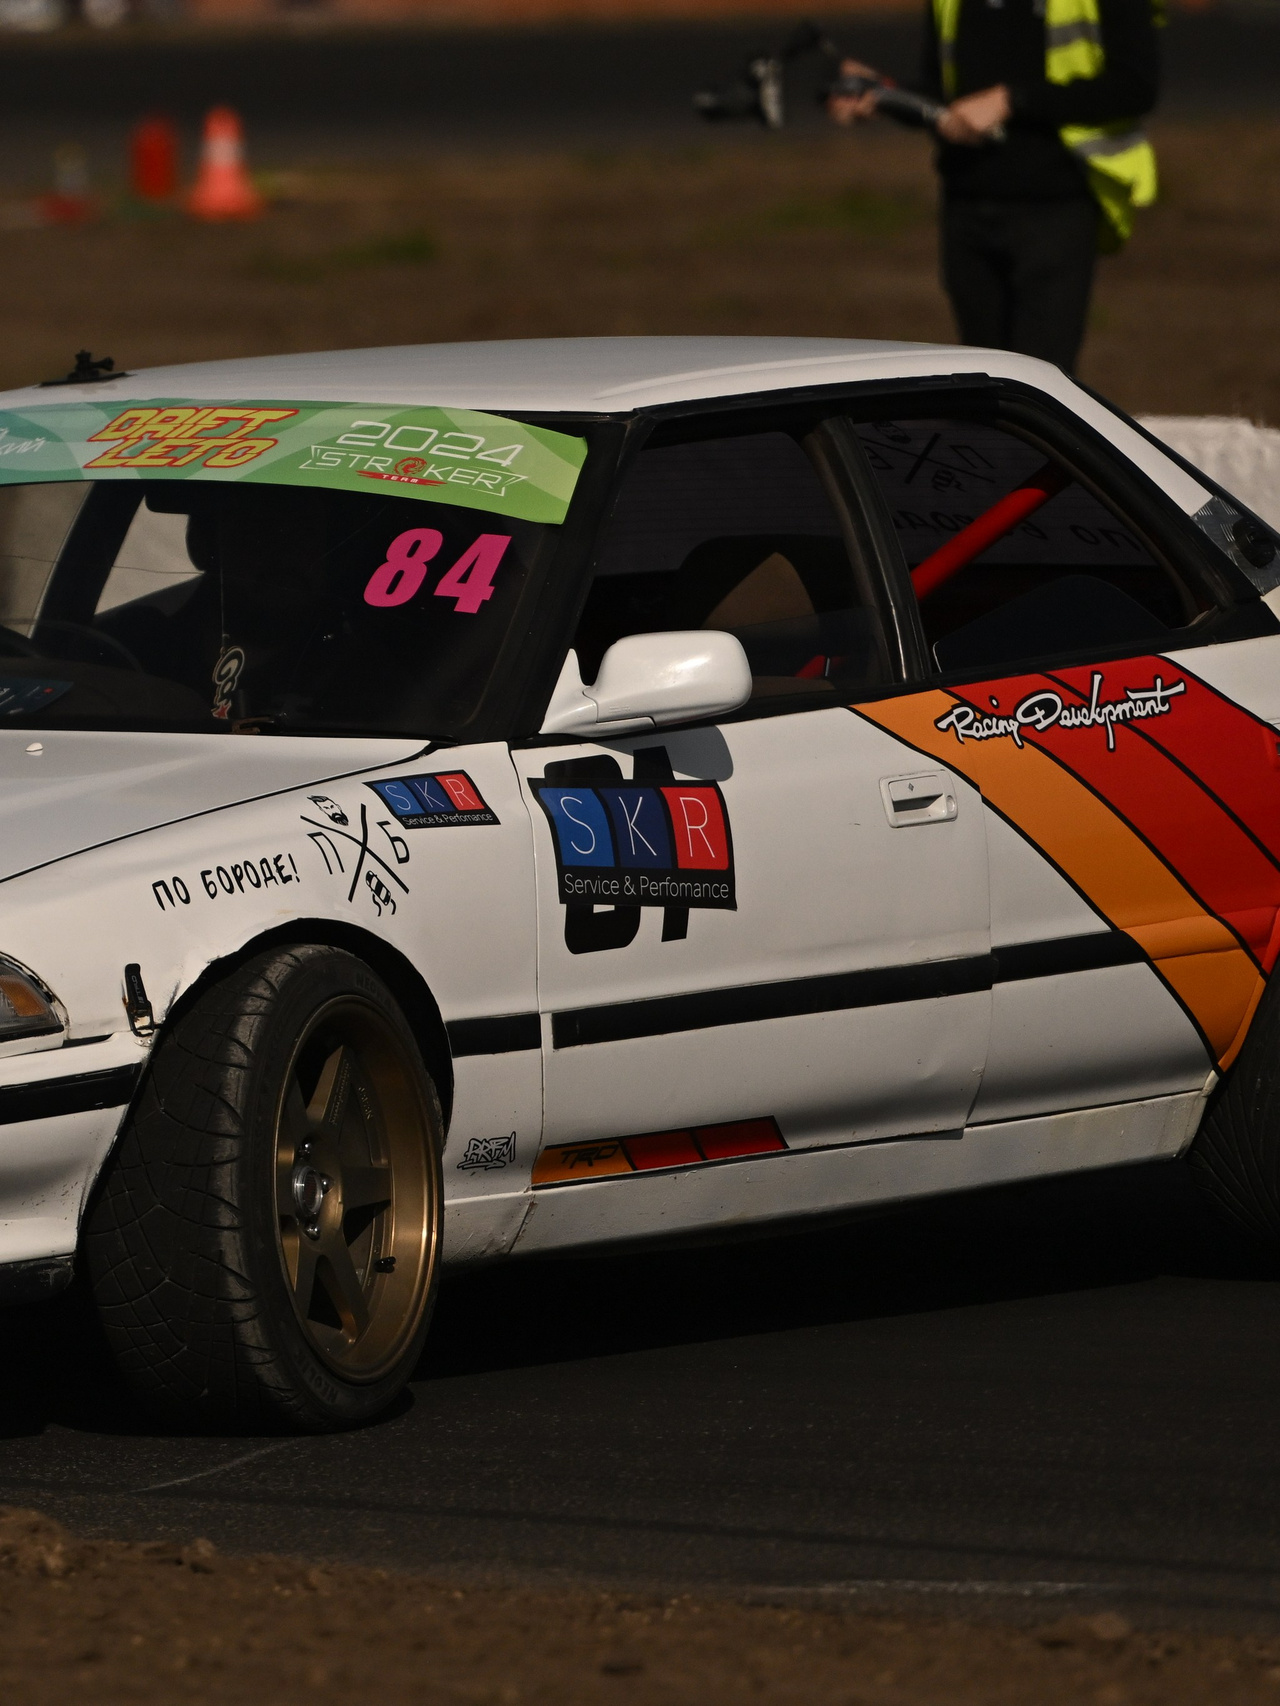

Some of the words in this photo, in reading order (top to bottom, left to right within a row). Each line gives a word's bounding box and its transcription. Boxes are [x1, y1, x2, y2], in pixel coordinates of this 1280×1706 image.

[86, 407, 300, 442] DRIFT
[82, 437, 278, 469] LETO
[336, 420, 524, 467] 2024
[382, 473, 420, 484] TEAM
[363, 527, 512, 613] 84
[937, 698, 1024, 747] Racing
[385, 778, 475, 811] SKR
[402, 814, 434, 826] Service
[434, 814, 443, 824] &
[444, 812, 494, 824] Perfomance
[559, 796, 716, 859] SKR
[152, 876, 191, 911] ПО
[200, 853, 300, 900] БОРОДЕ!
[564, 873, 620, 896] Service
[623, 875, 637, 896] &
[639, 875, 730, 899] Perfomance
[561, 1144, 619, 1169] TRD
